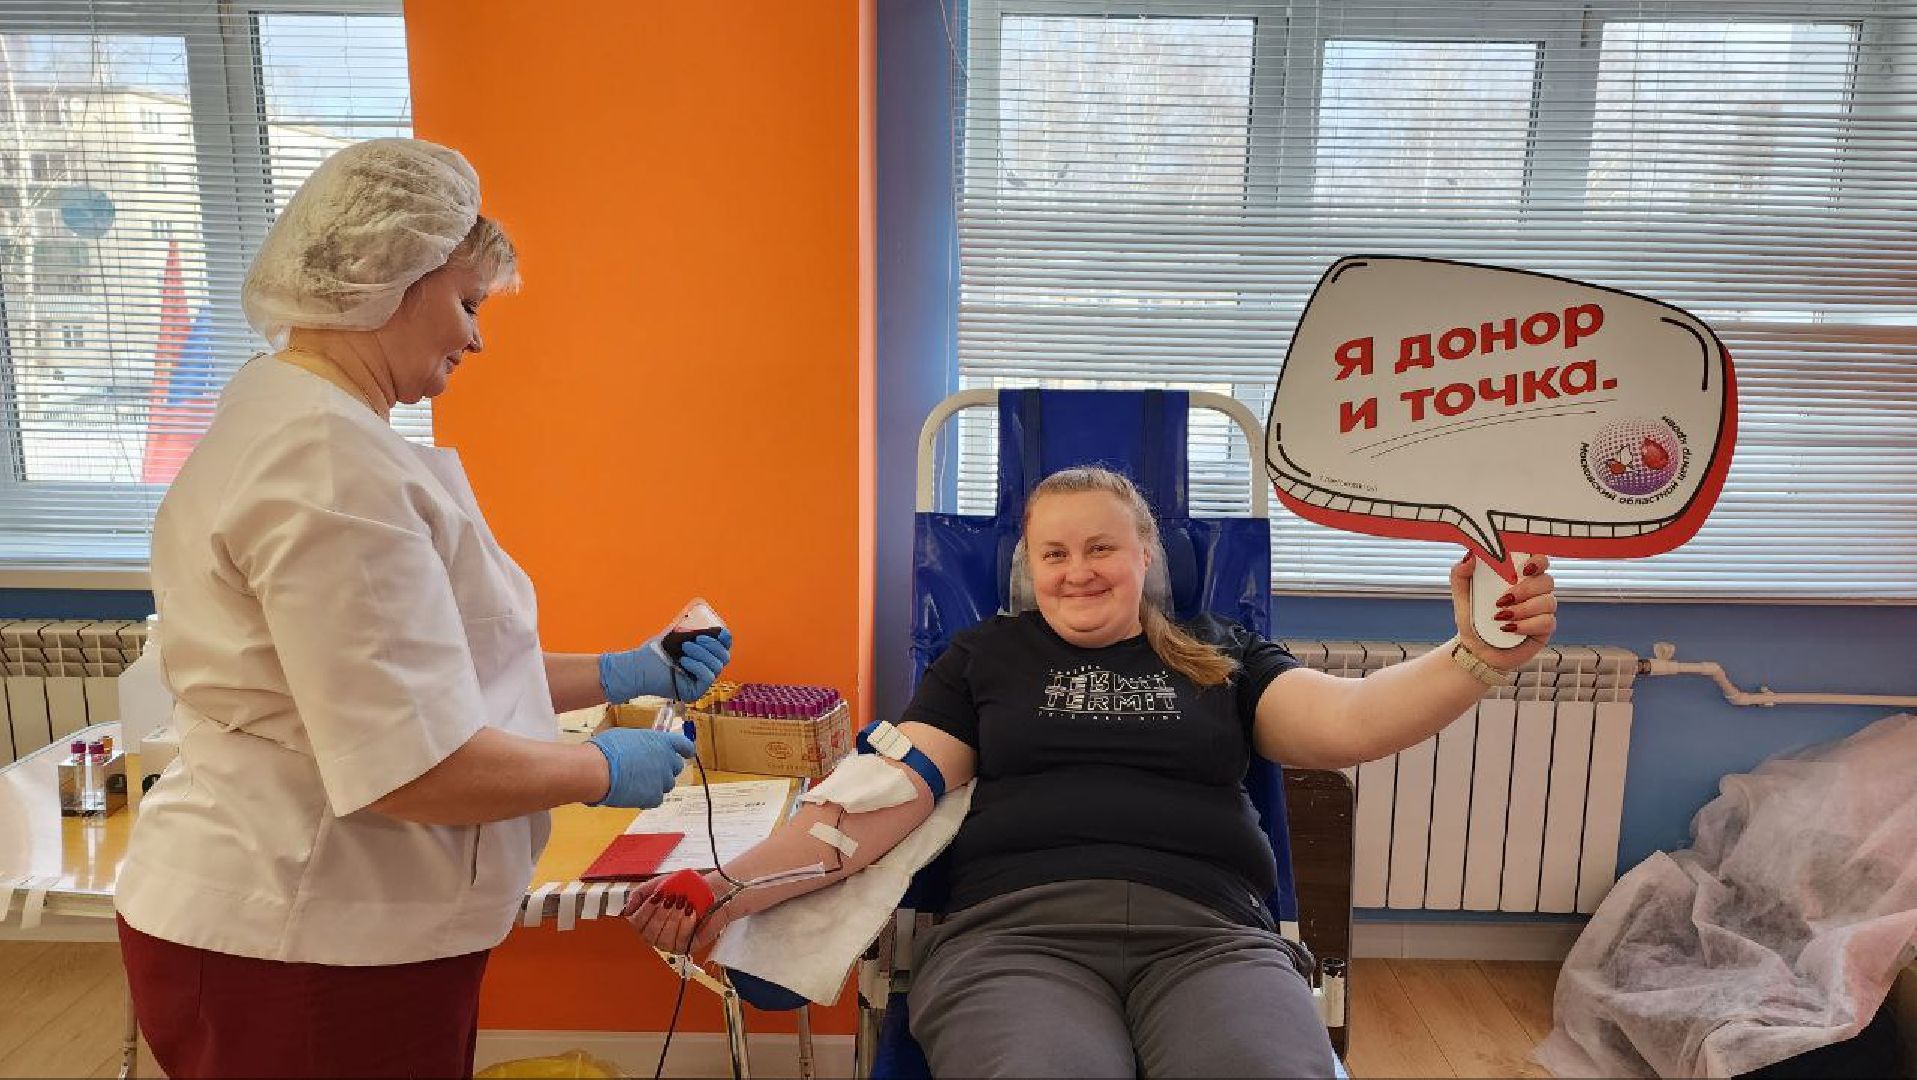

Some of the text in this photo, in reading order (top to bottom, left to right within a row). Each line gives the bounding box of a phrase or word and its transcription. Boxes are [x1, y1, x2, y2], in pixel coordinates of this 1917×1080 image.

[1335, 303, 1604, 381] Я донор
[1340, 359, 1618, 434] и точка.
[1619, 481, 1679, 505] областной
